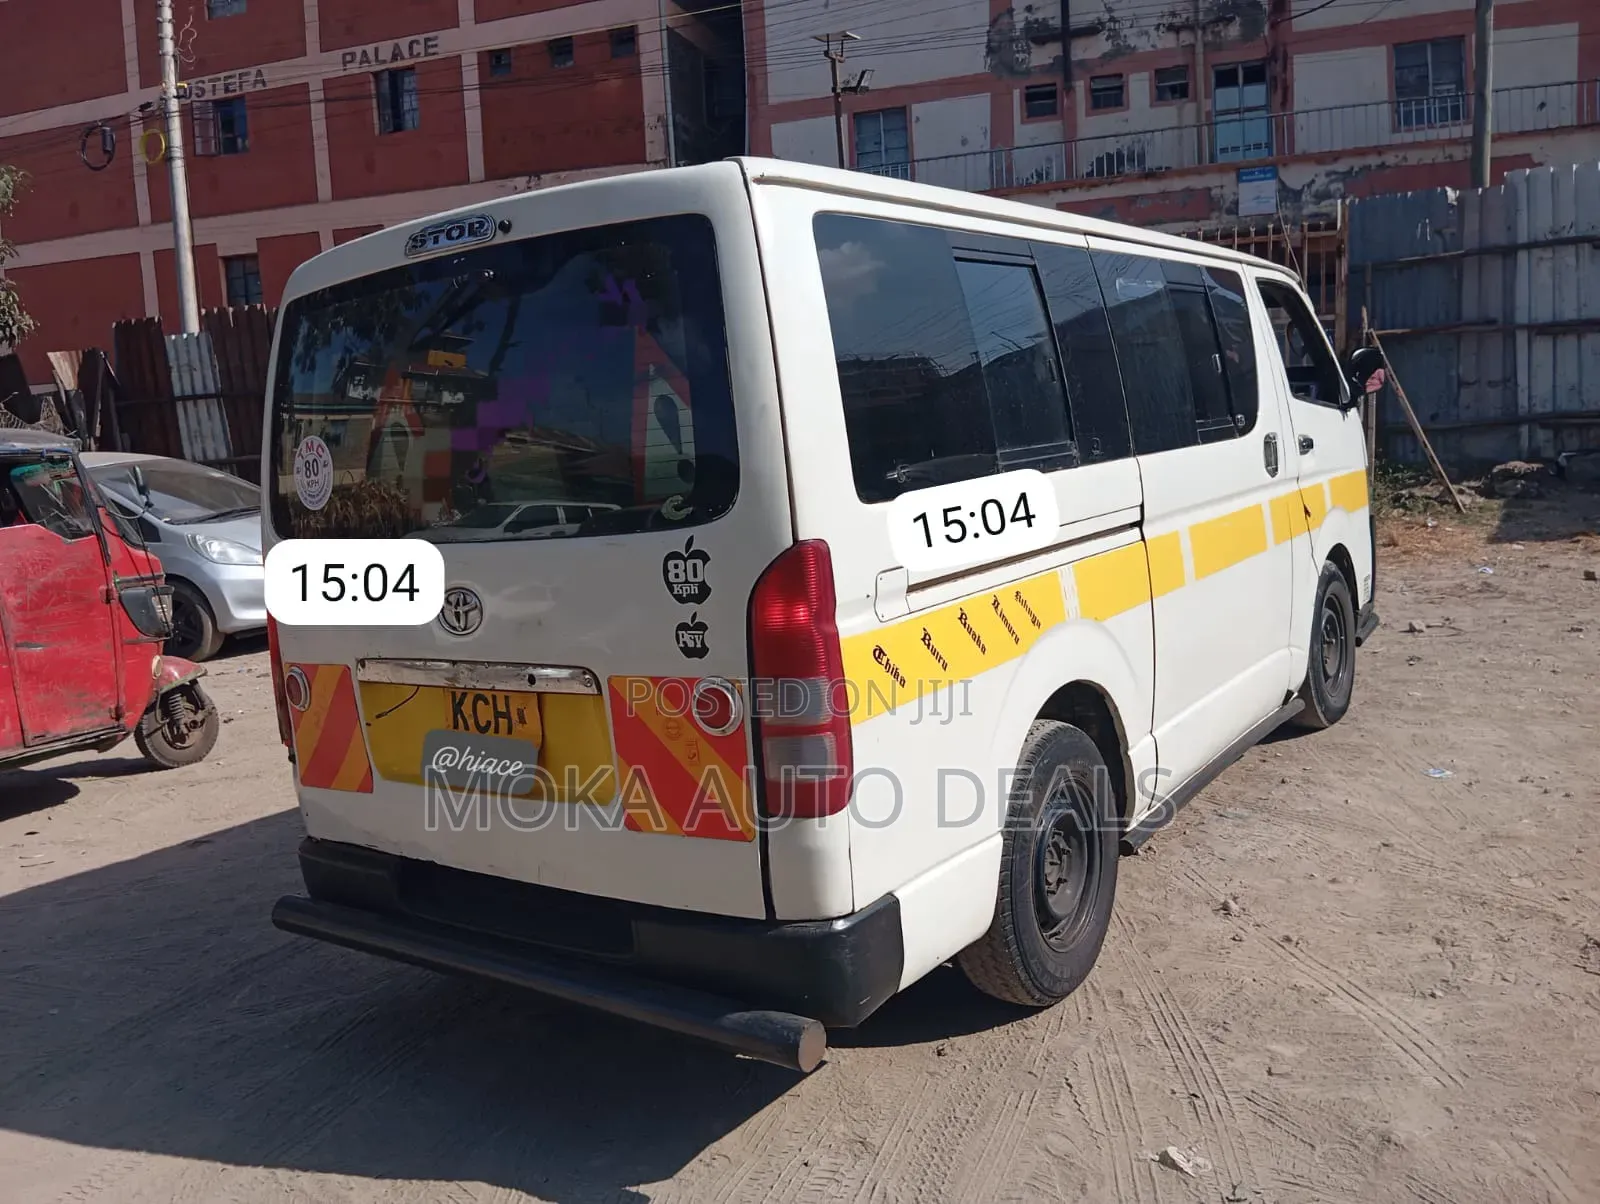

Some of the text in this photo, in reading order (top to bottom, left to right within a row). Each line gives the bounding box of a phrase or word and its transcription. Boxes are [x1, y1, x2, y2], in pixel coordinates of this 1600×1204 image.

[176, 35, 440, 102] USTEFA PALACE
[410, 218, 488, 249] STOP
[303, 458, 320, 479] 80
[306, 478, 320, 490] KPH
[667, 558, 704, 584] 80
[671, 583, 699, 598] Kph
[677, 630, 704, 648] PSV
[872, 644, 907, 688] Thika
[450, 690, 514, 736] KCH
